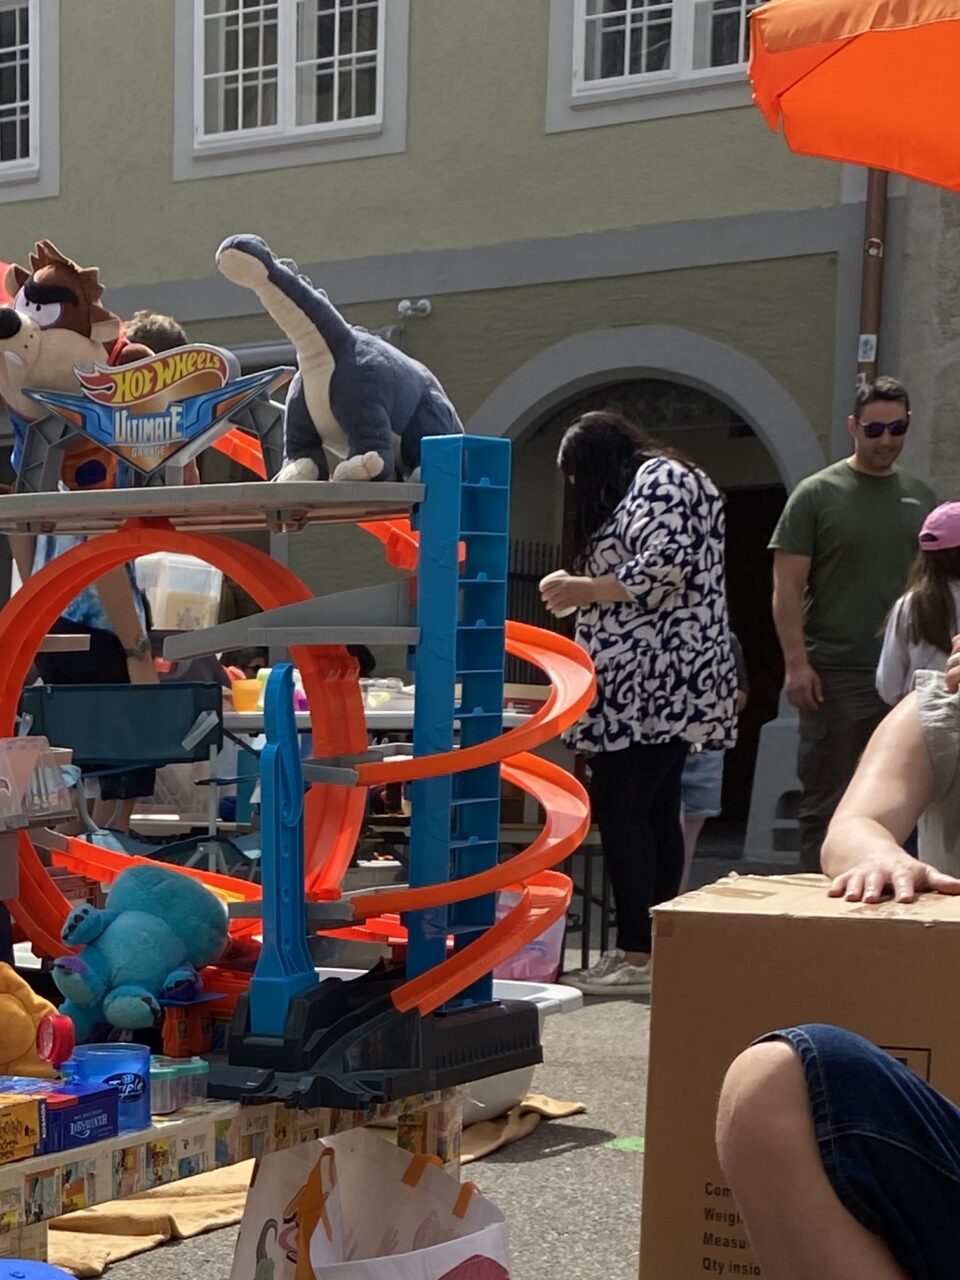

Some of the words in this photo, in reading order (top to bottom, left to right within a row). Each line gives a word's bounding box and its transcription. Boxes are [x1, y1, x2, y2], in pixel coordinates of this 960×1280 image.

[111, 368, 154, 403] HOT
[115, 405, 184, 443] ULTIMATE
[702, 1257, 725, 1275] Qty
